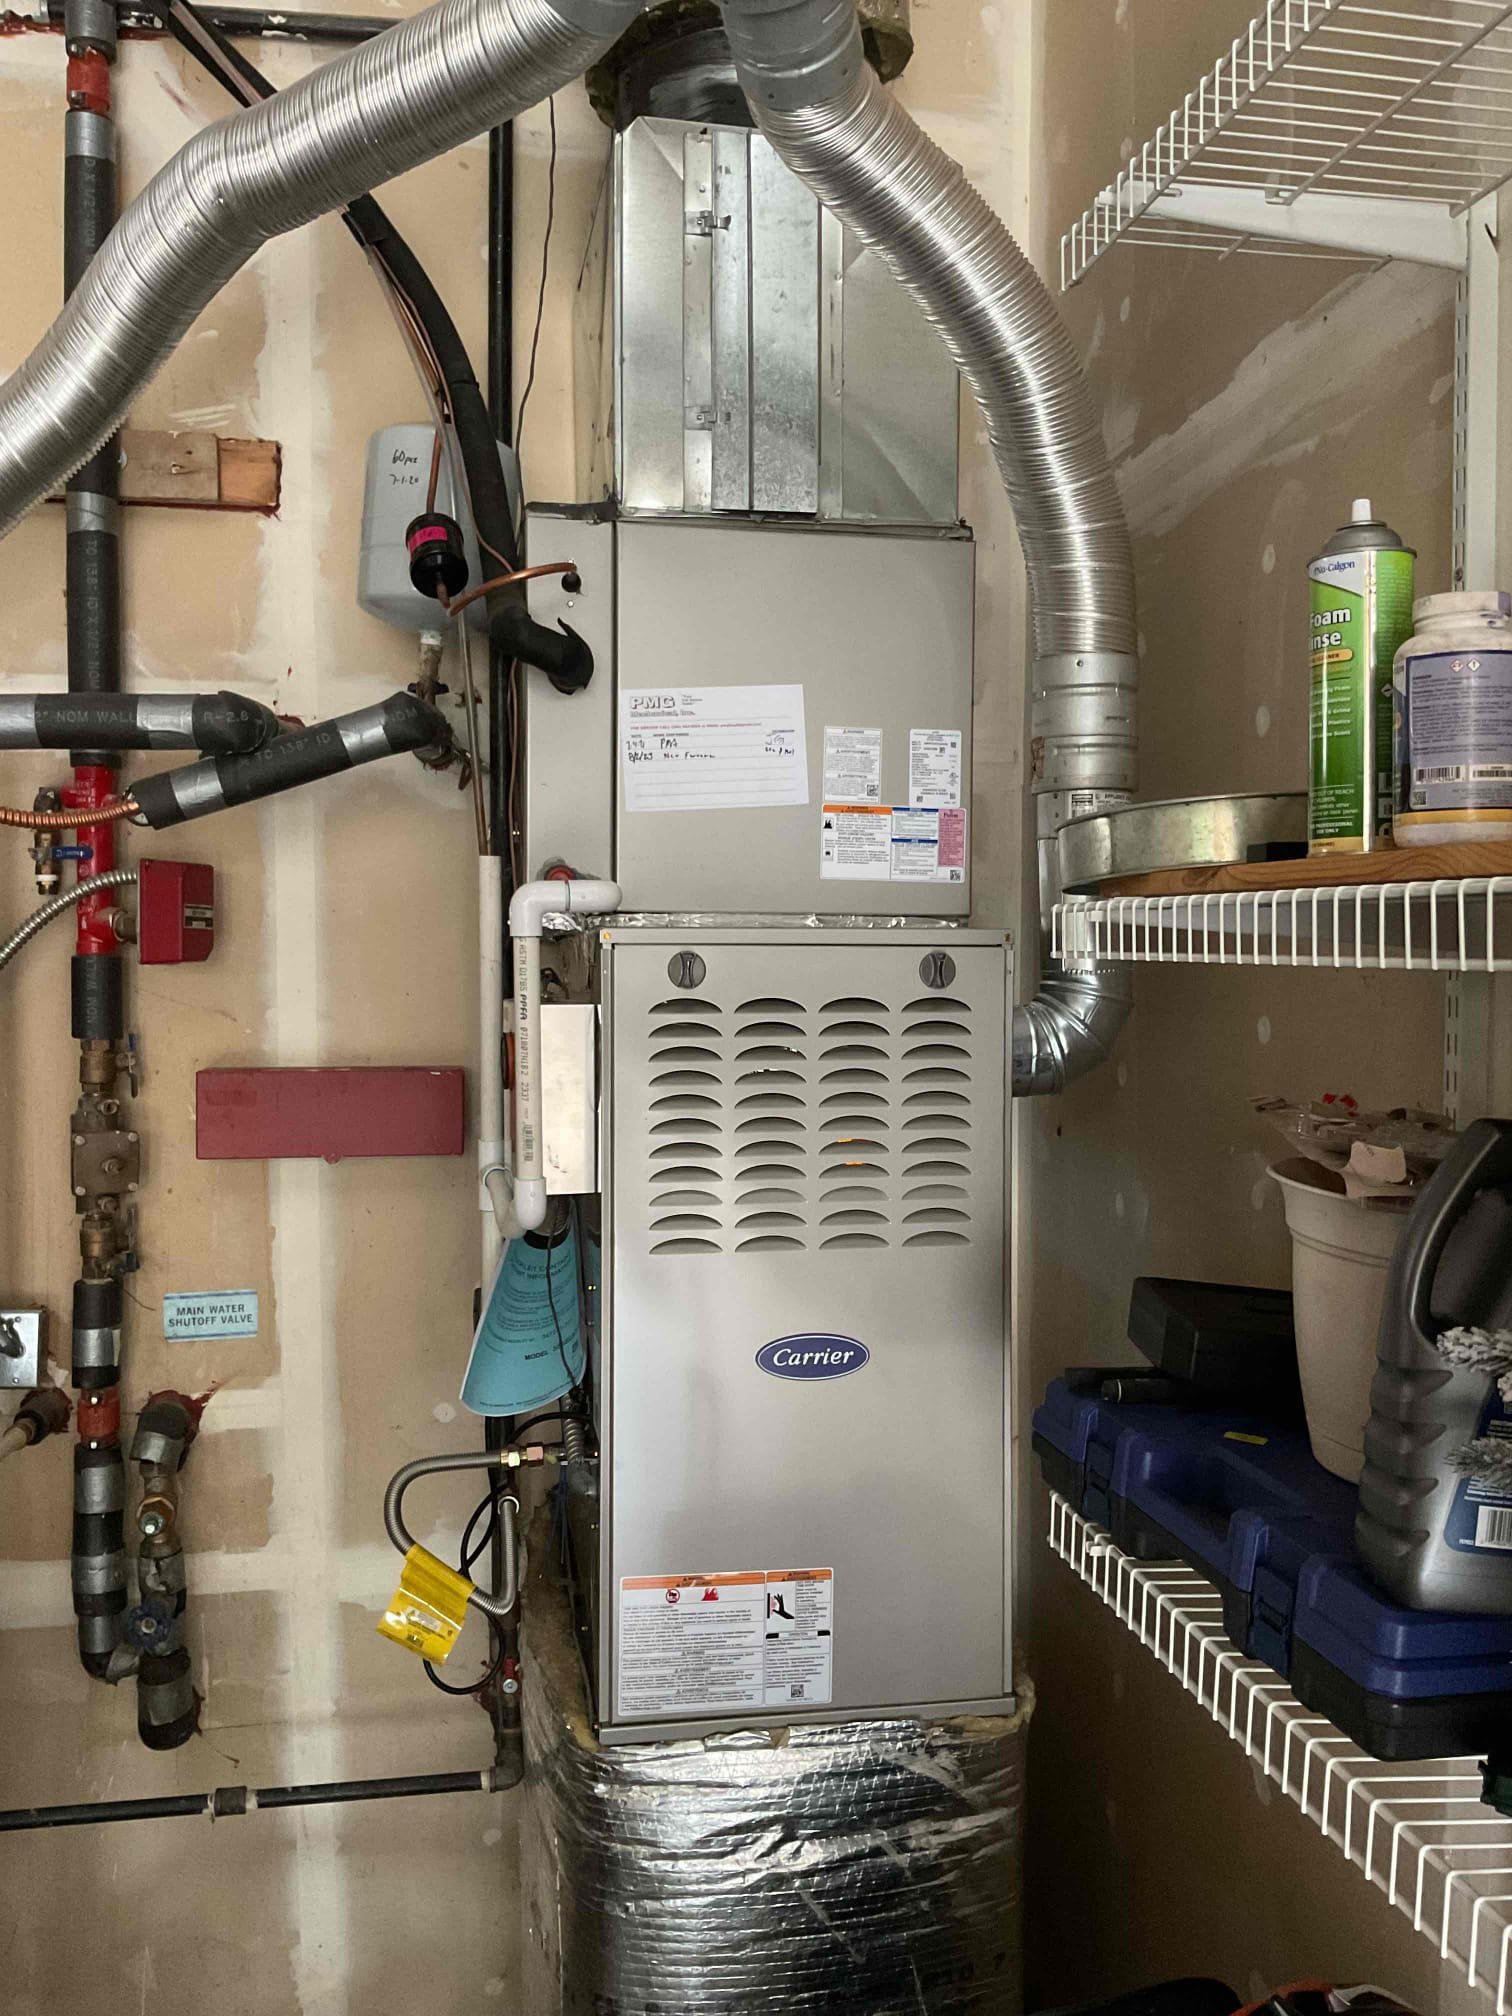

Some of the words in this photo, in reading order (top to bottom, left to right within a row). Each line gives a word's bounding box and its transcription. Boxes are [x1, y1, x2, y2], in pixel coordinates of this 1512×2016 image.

[1311, 608, 1351, 628] oam
[630, 696, 676, 710] PMG
[56, 710, 89, 724] NOM
[519, 993, 528, 1021] PPFA
[176, 1306, 205, 1317] MAIN
[209, 1303, 245, 1314] WATER
[168, 1316, 217, 1328] SHUTOFF
[220, 1314, 254, 1324] VALVE
[773, 1348, 855, 1367] Carrier
